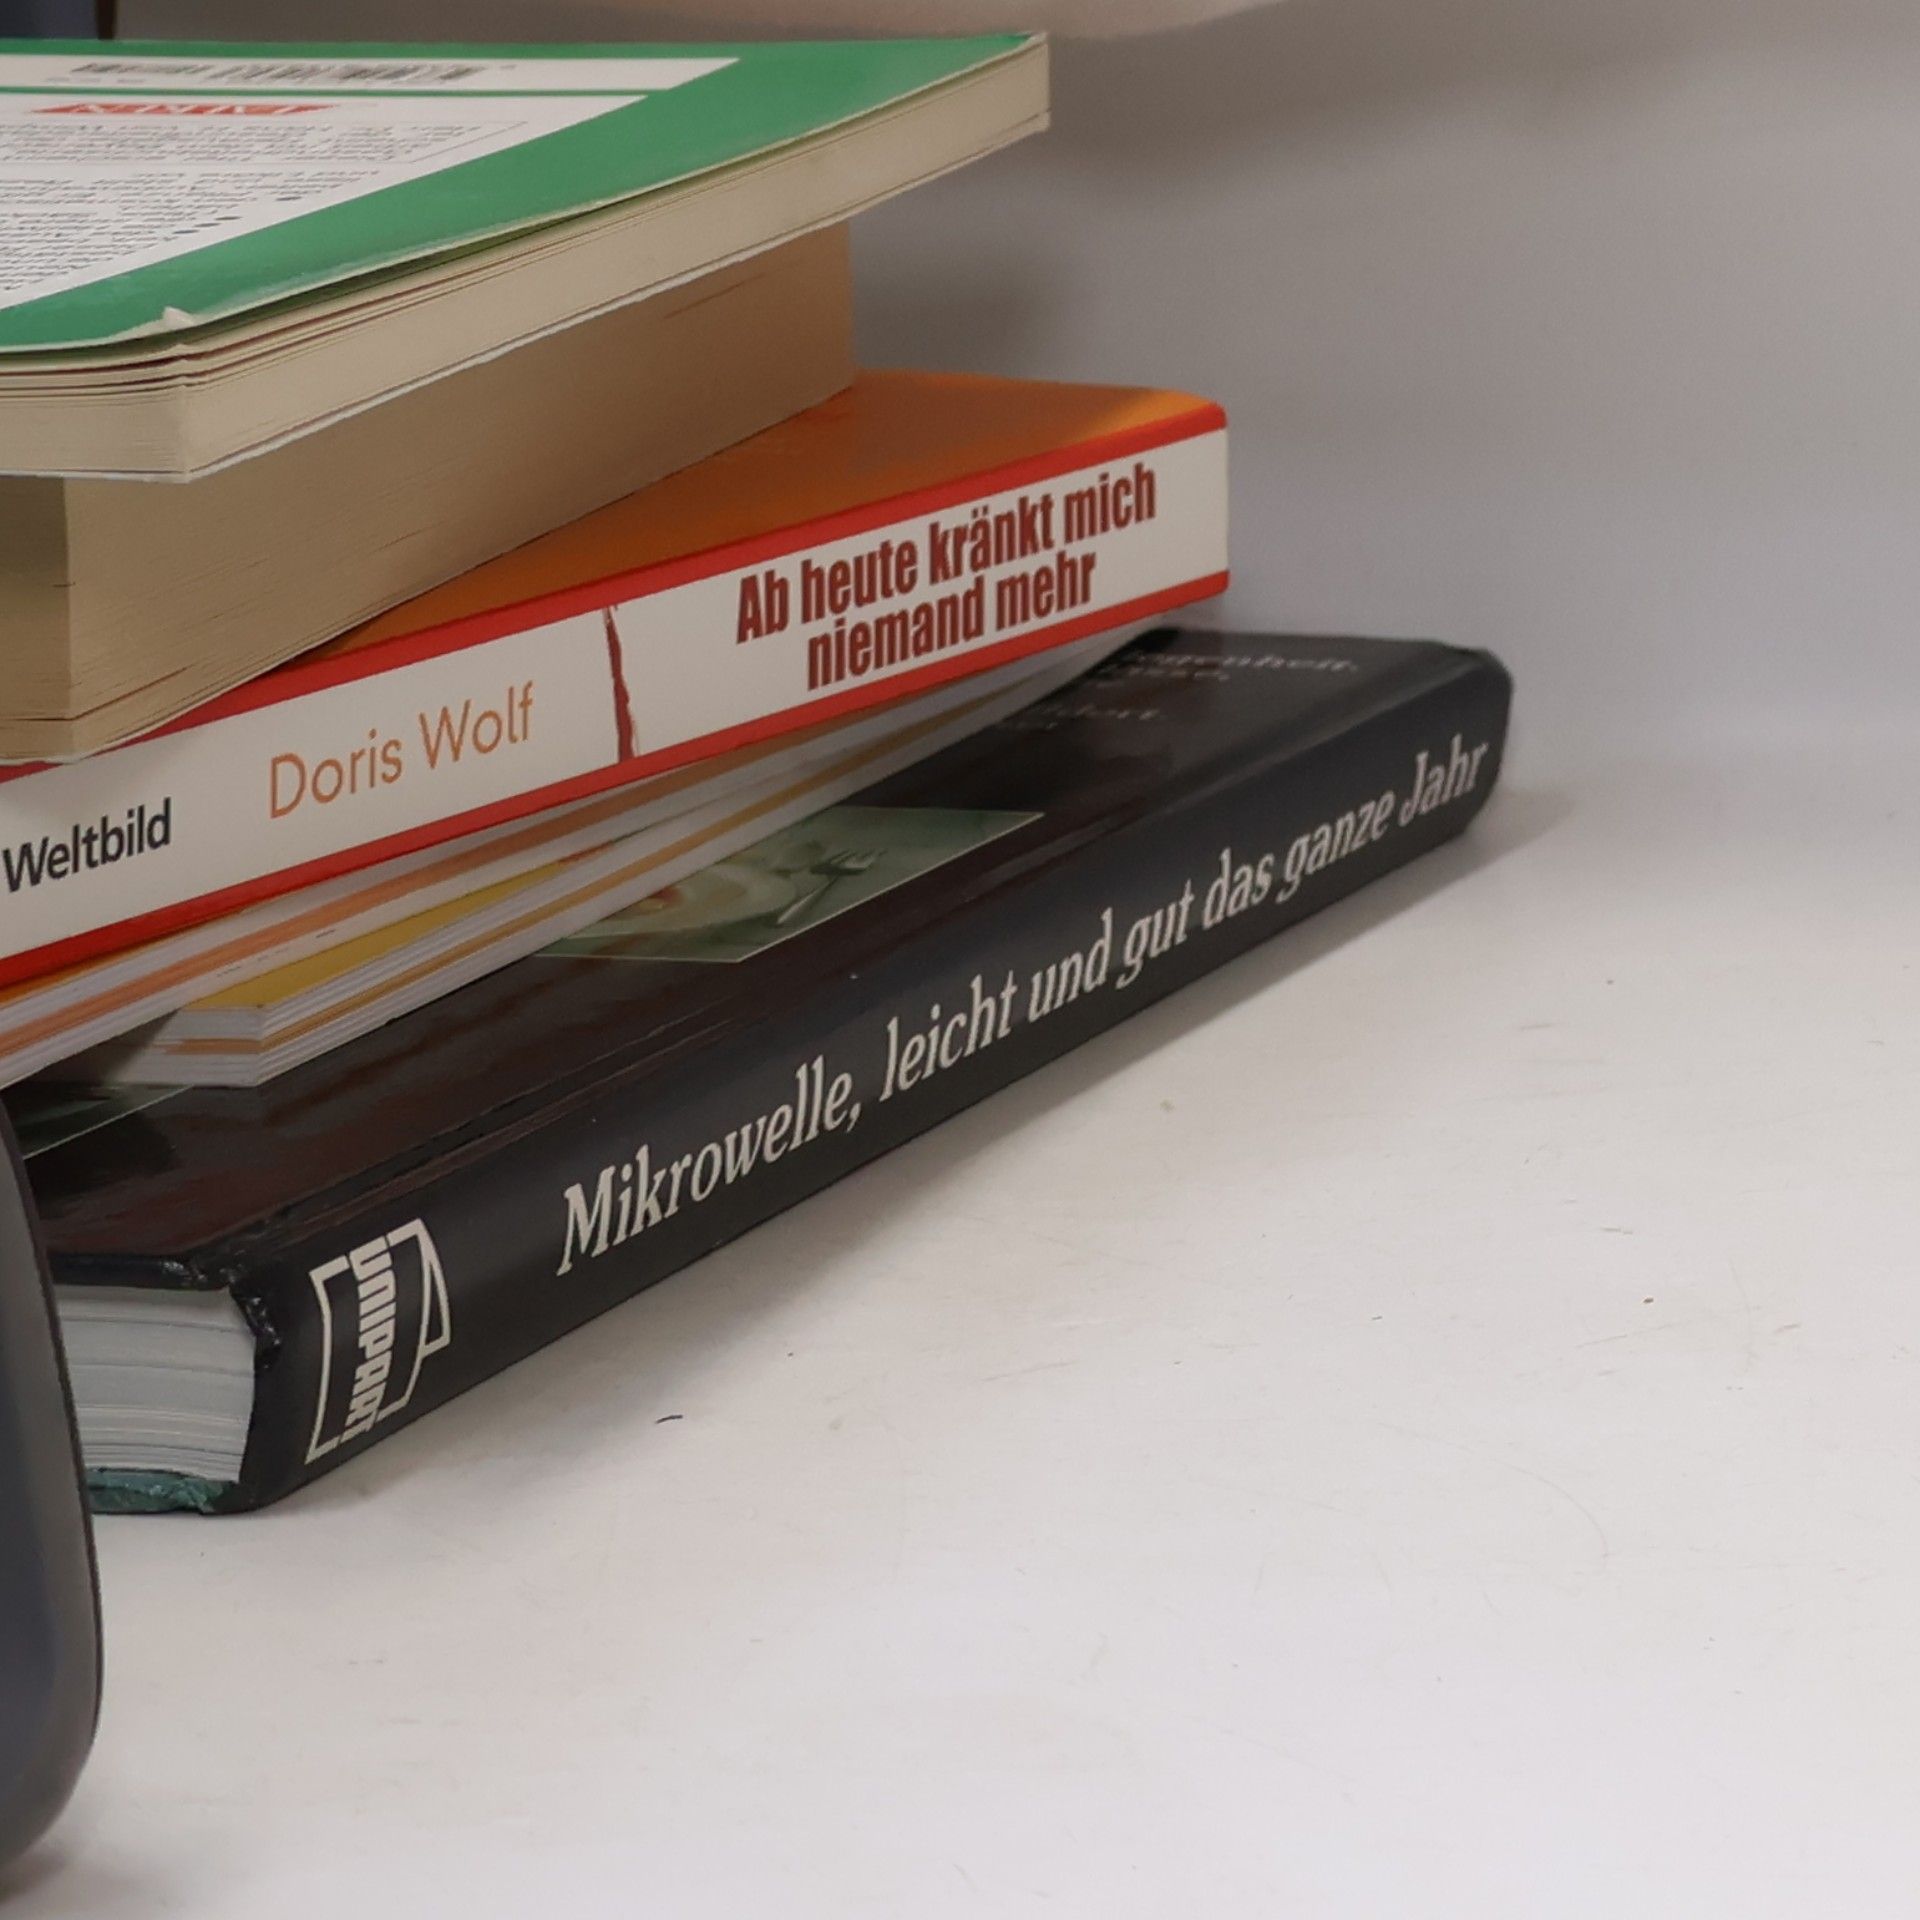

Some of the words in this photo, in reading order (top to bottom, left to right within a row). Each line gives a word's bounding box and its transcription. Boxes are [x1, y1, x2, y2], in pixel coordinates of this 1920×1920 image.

[736, 569, 789, 645] Ab
[801, 540, 918, 624] heute
[926, 493, 1055, 586] kränkt
[1064, 462, 1156, 544] mich
[808, 575, 985, 691] niemand
[995, 550, 1096, 632] mehr
[270, 728, 403, 819] Doris
[418, 680, 533, 770] Wolf
[2, 796, 171, 893] Weltbild
[556, 1054, 861, 1276] Mikrowelle,
[879, 970, 1018, 1102] leicht
[1028, 907, 1113, 1022] und
[1116, 879, 1195, 989] gut
[1202, 848, 1275, 929] das
[1276, 791, 1395, 903] ganze
[1398, 733, 1489, 827] Jahr
